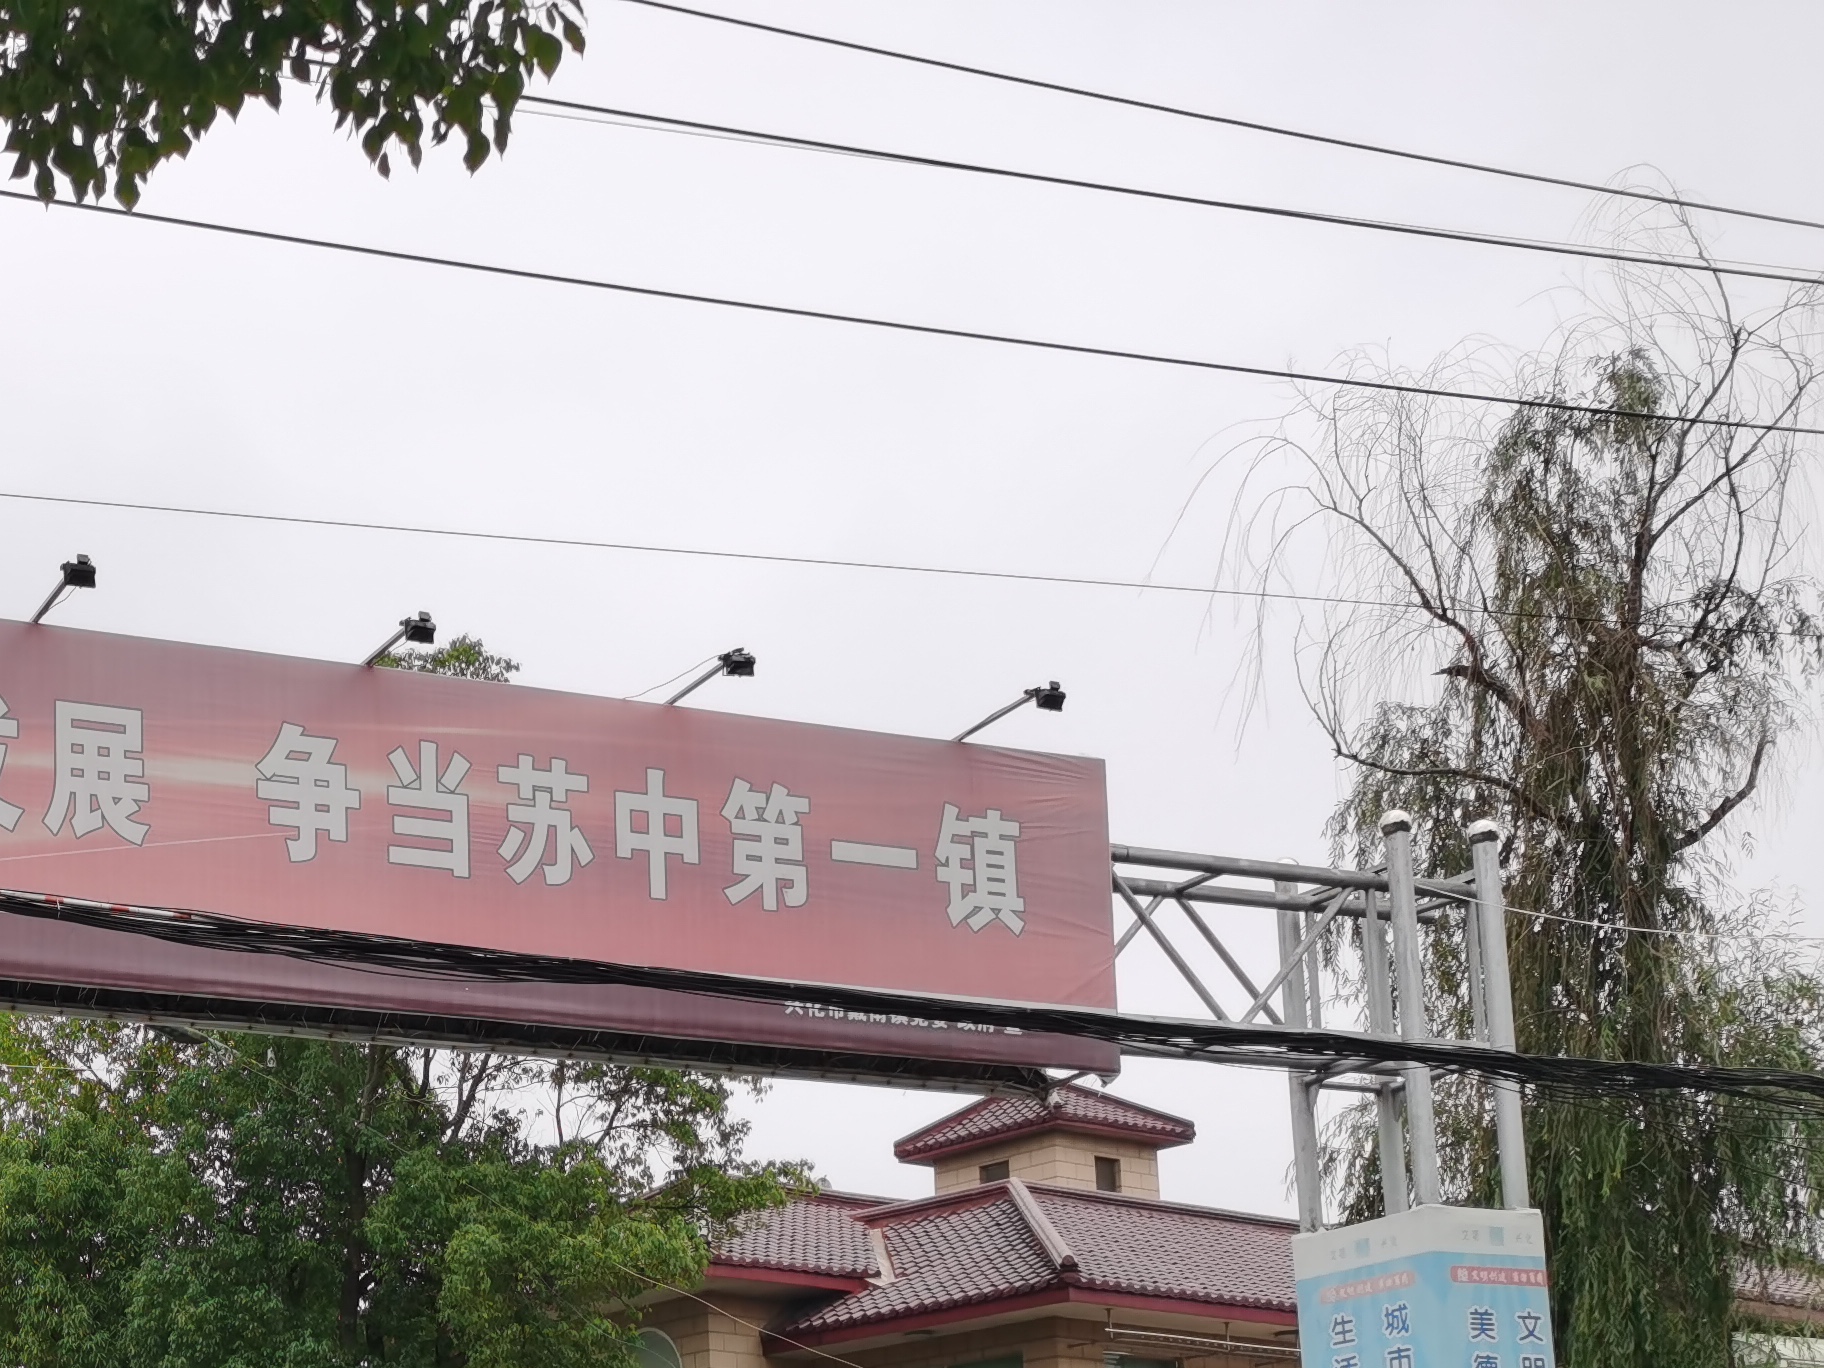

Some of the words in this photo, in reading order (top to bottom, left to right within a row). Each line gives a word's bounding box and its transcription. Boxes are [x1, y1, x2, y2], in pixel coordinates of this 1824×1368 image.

[255, 721, 1027, 937] 争当苏中第一镇
